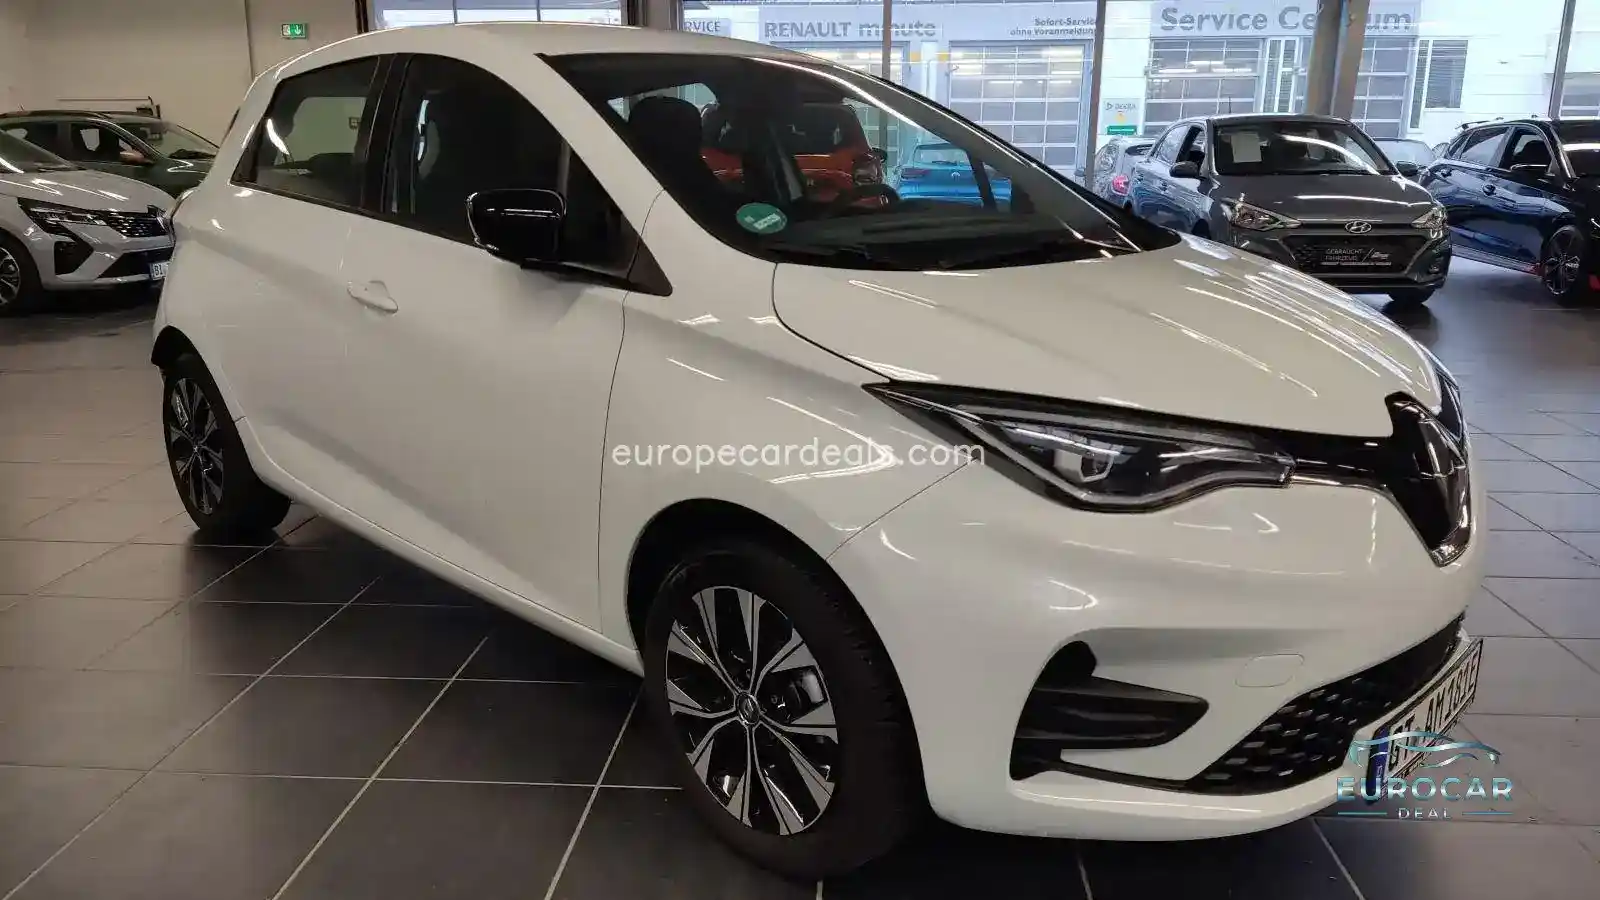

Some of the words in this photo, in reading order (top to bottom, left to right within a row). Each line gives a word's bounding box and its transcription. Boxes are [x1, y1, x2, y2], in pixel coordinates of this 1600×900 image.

[1034, 18, 1096, 26] Sofort-Servic
[1160, 7, 1268, 31] Service
[1278, 6, 1411, 31] Ceum
[684, 21, 721, 33] RVICE
[764, 22, 851, 37] RENAULT
[859, 20, 936, 37] mnute
[1034, 26, 1096, 36] Voranmeldun
